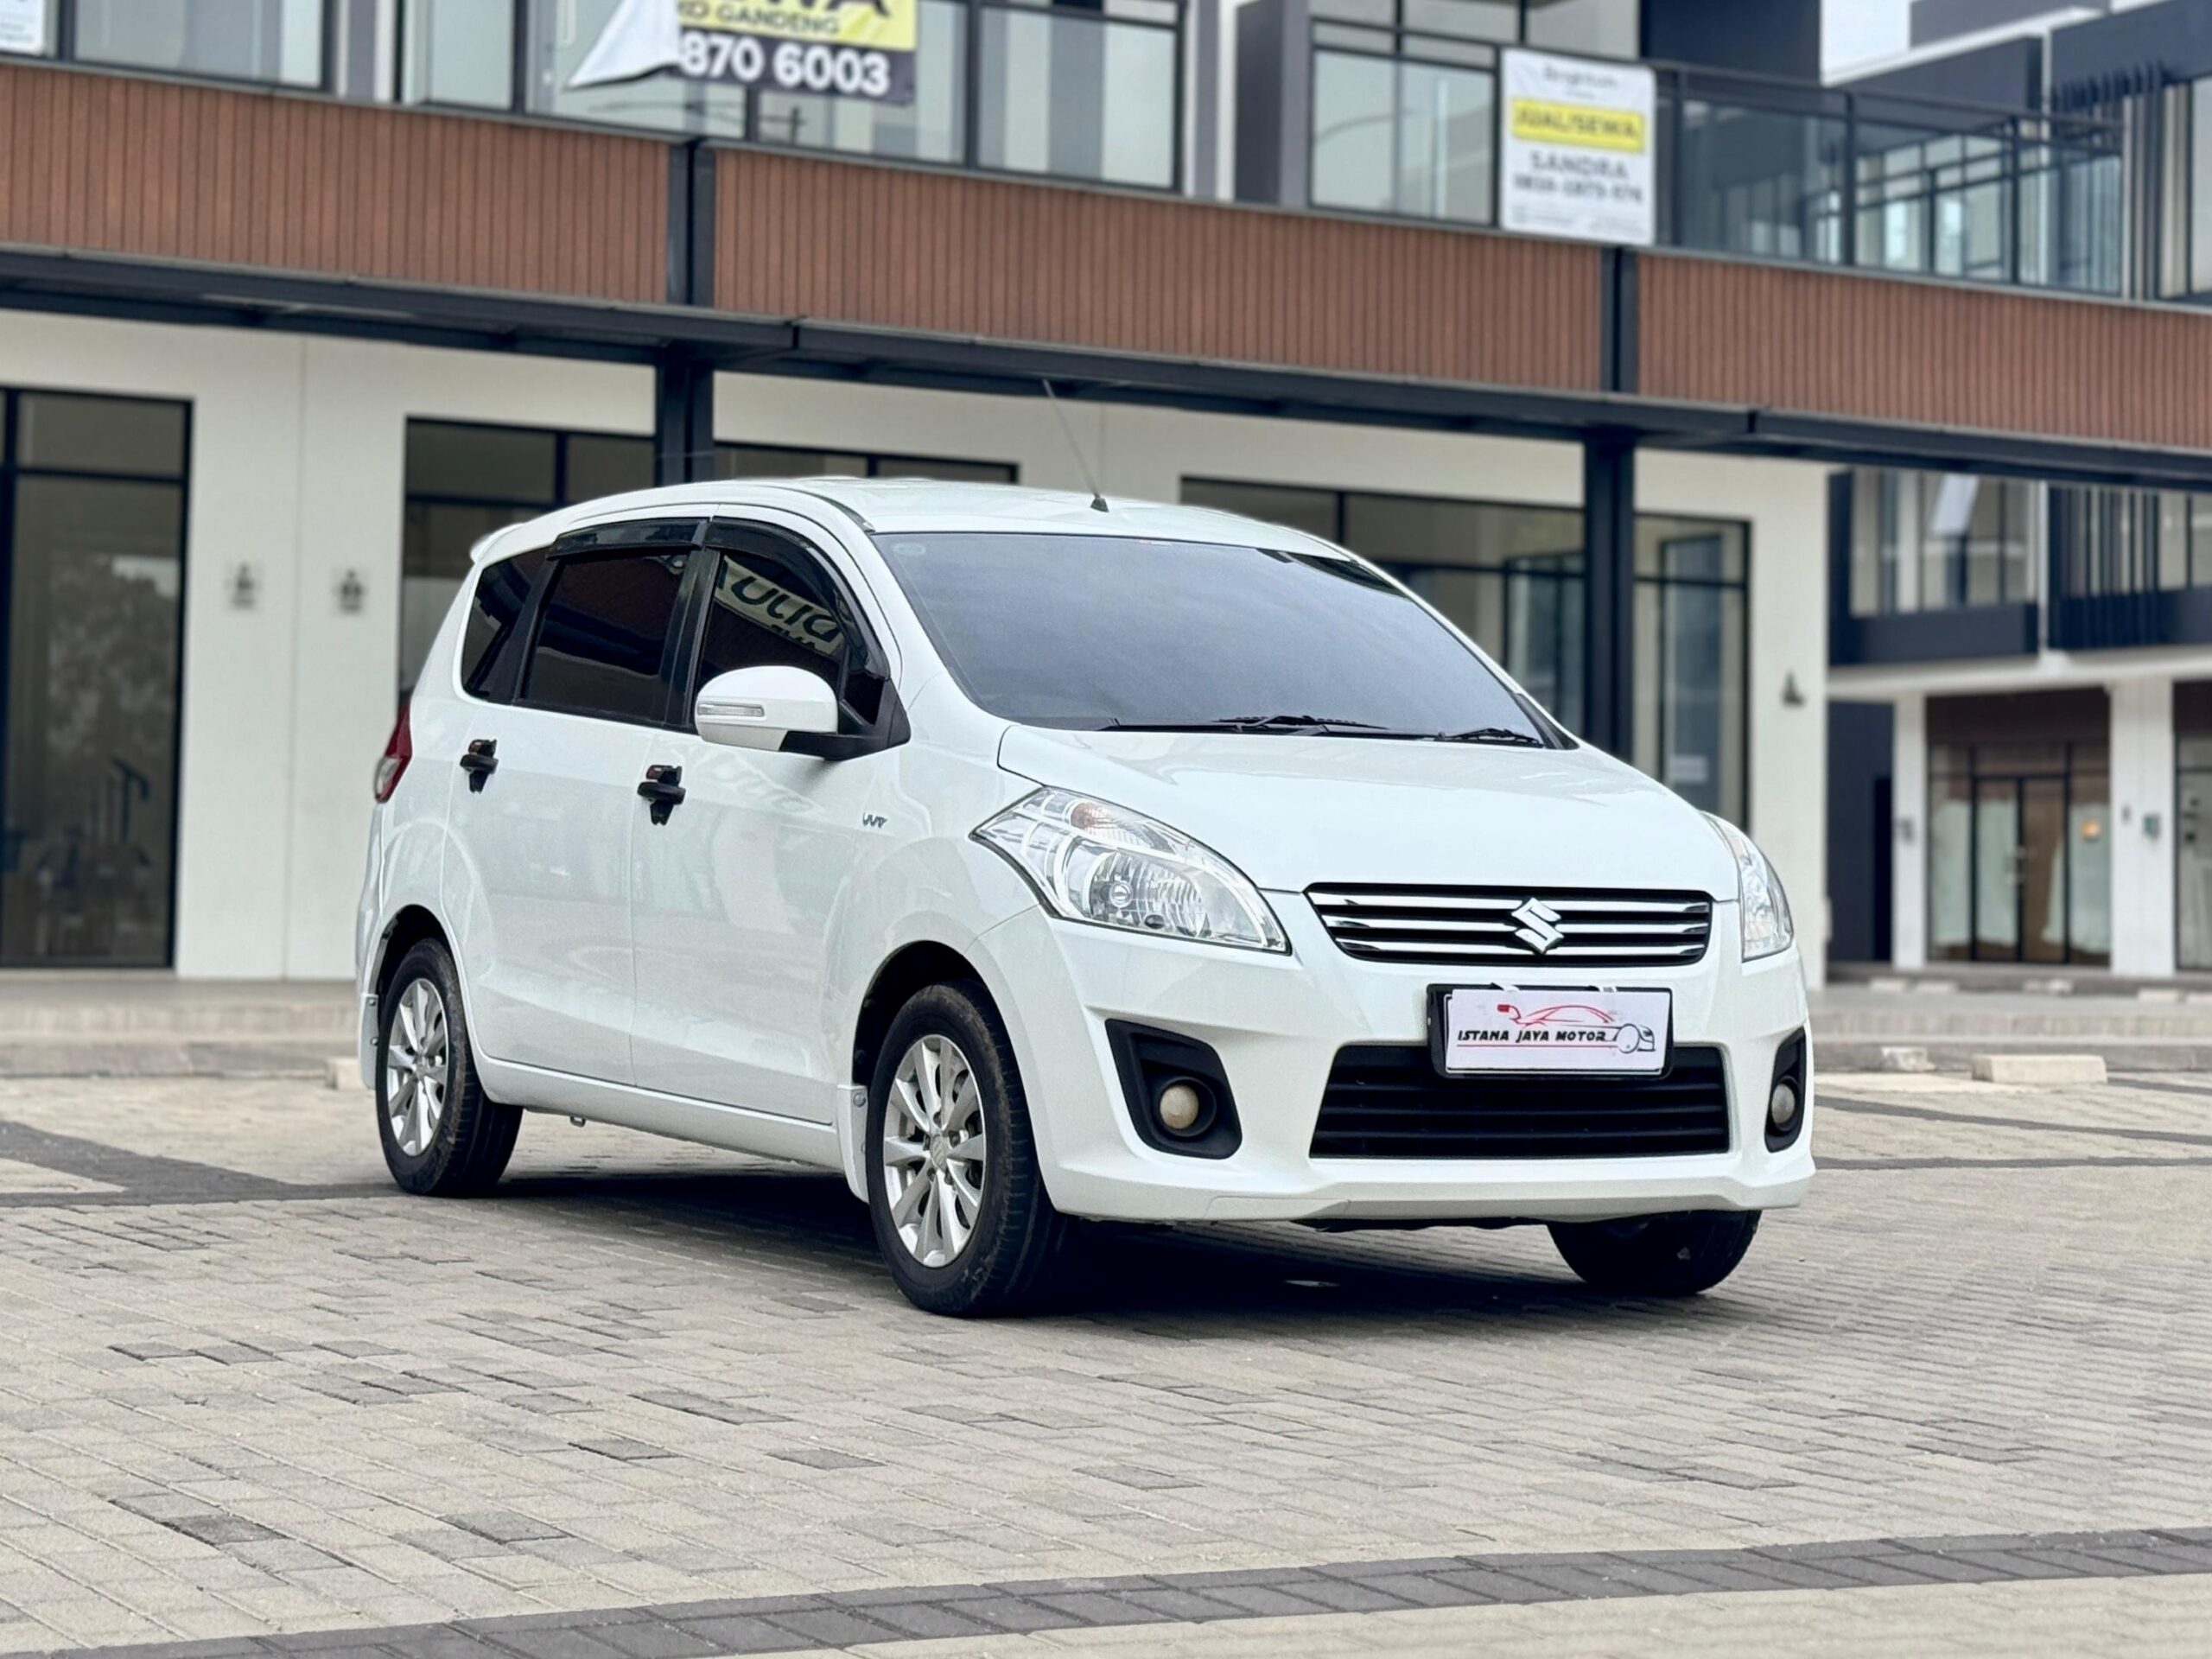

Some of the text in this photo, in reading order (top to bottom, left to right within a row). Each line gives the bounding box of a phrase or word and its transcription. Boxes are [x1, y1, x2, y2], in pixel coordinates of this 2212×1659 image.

[715, 3, 839, 35] GANDENG
[680, 31, 890, 96] 870 6003
[1530, 150, 1629, 178] SANDRA
[1458, 1029, 1606, 1043] ISTANA JAYA MOTOR
